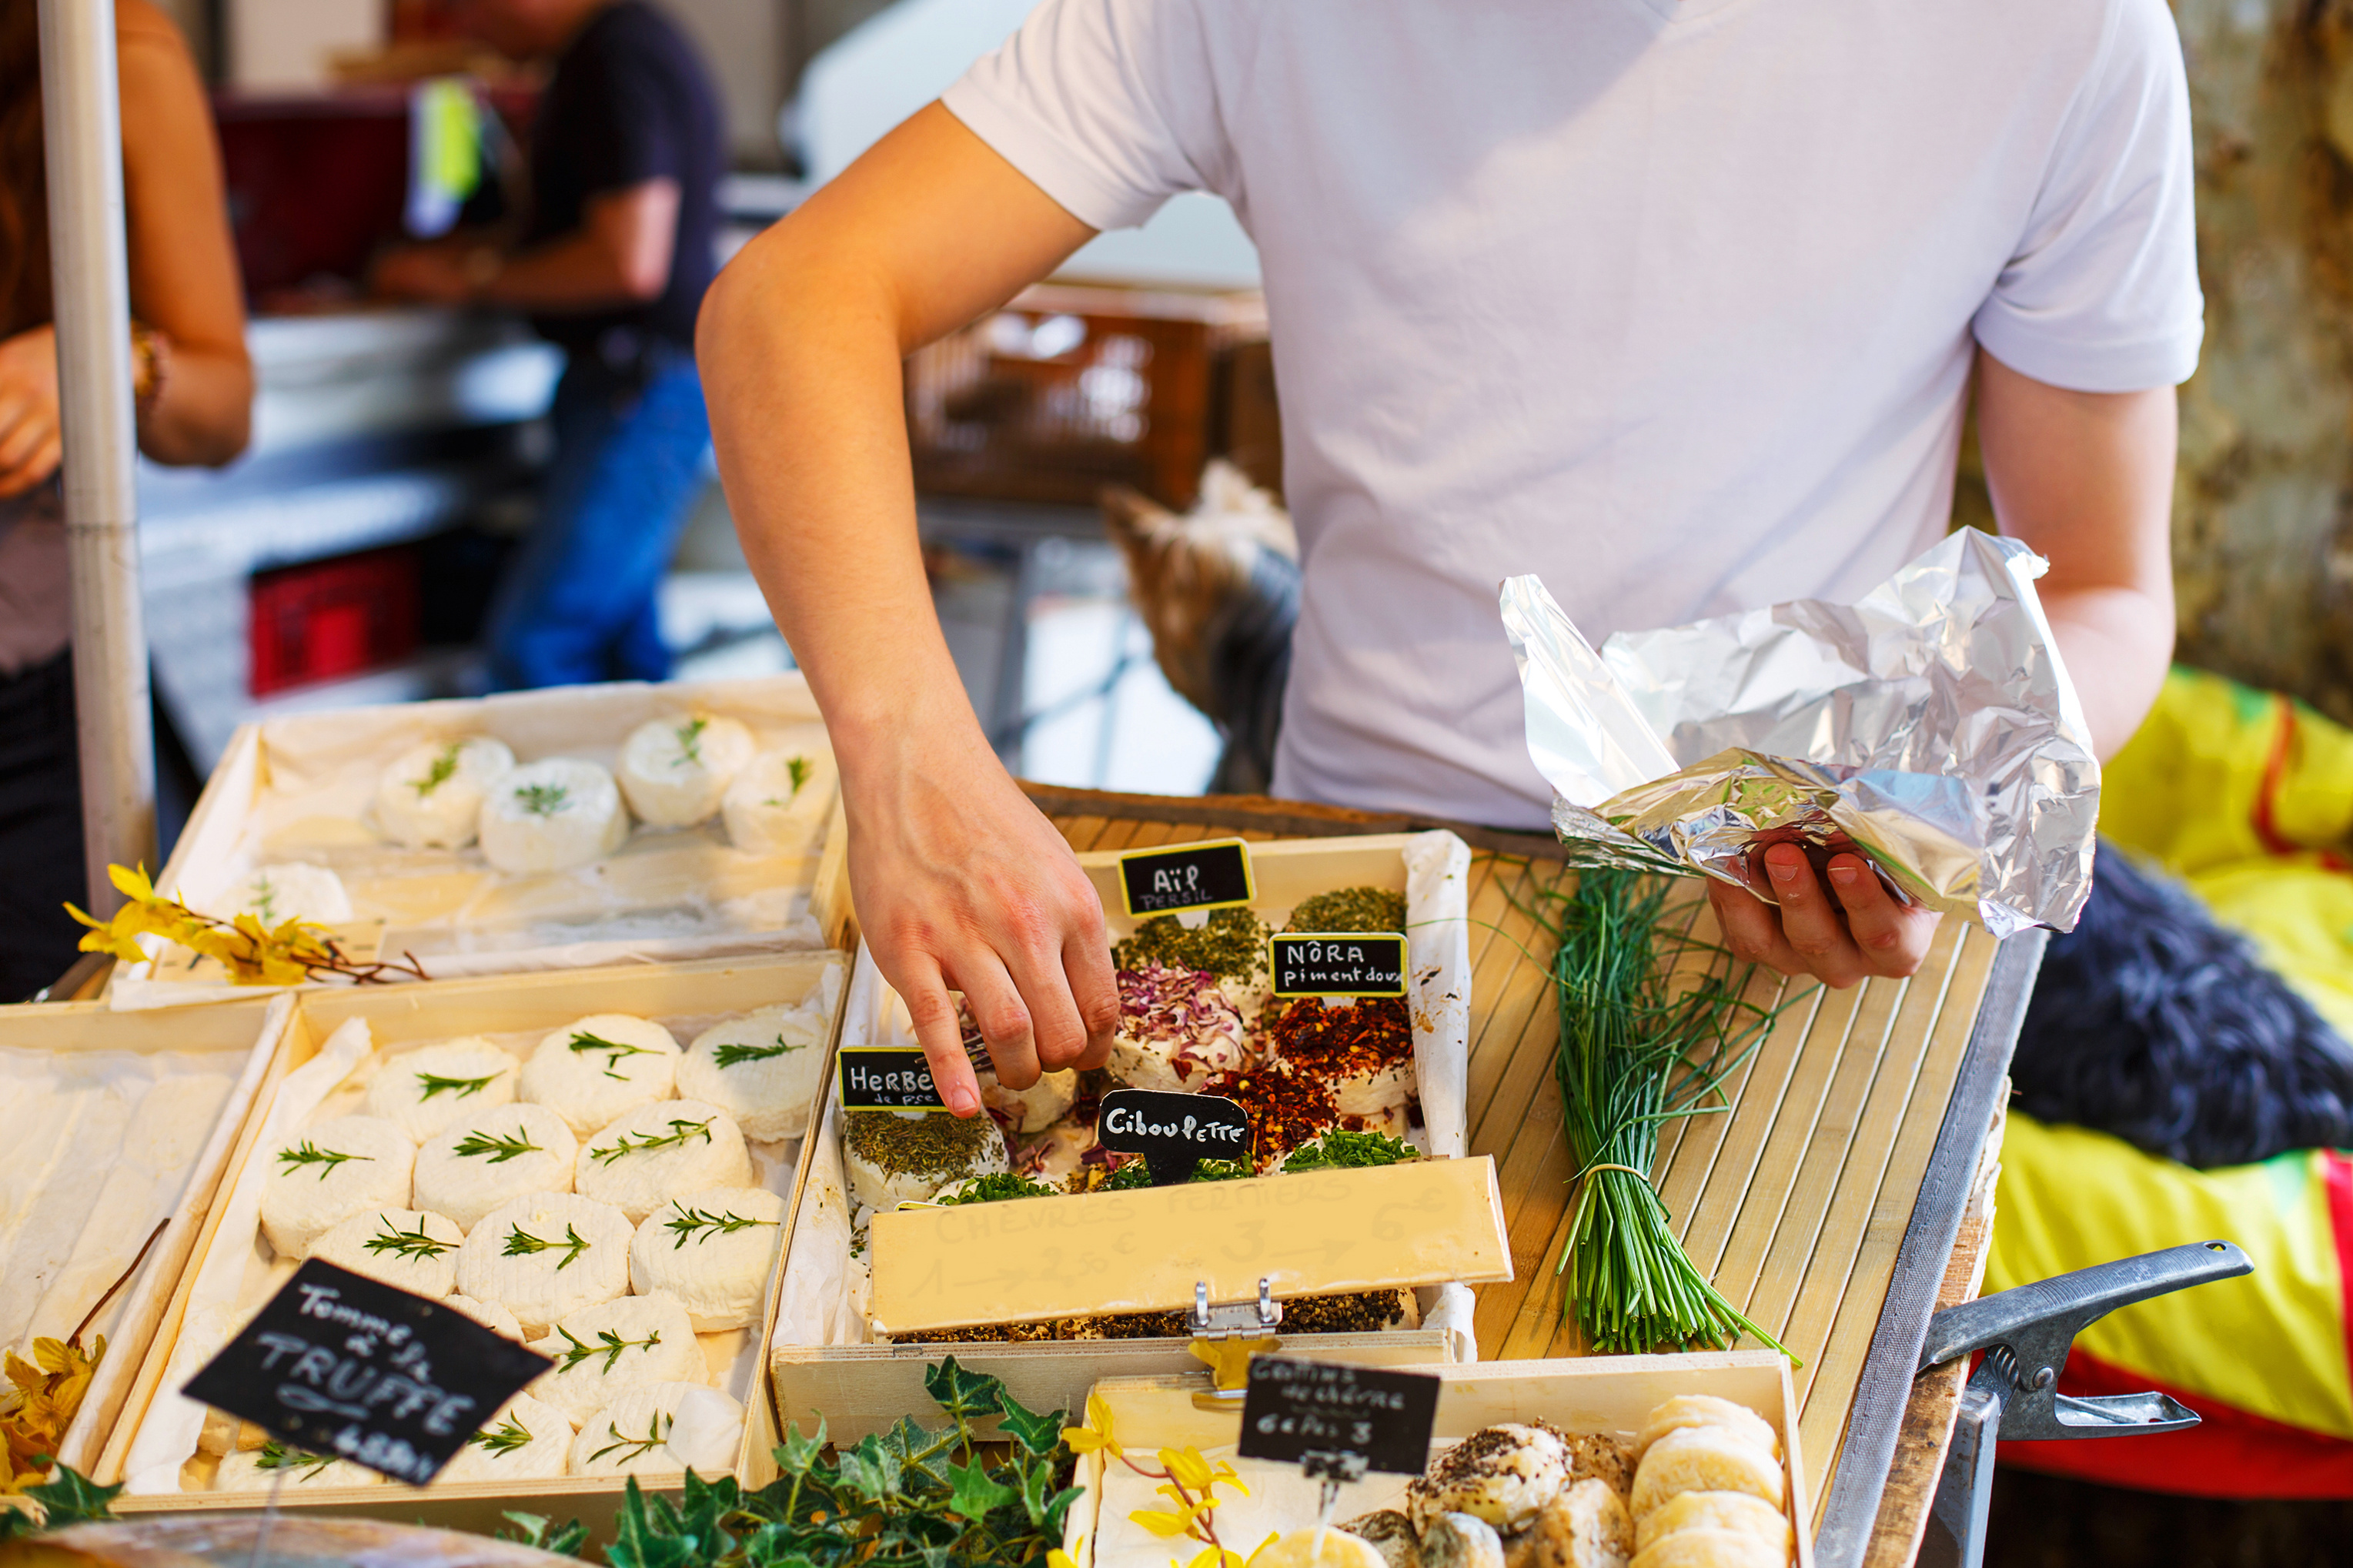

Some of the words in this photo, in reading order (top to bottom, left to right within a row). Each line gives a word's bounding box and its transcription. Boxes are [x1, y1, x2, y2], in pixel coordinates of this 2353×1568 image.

[1288, 940, 1364, 965] NÔRA
[1285, 966, 1362, 987] piment
[851, 1065, 934, 1093] HeRBe
[874, 1093, 893, 1105] de
[934, 1198, 1136, 1245] CHÈVRES
[1220, 1219, 1266, 1264] 3
[299, 1282, 412, 1346] Tomme
[256, 1332, 476, 1436] TRUFFE
[1349, 1422, 1373, 1445] 3
